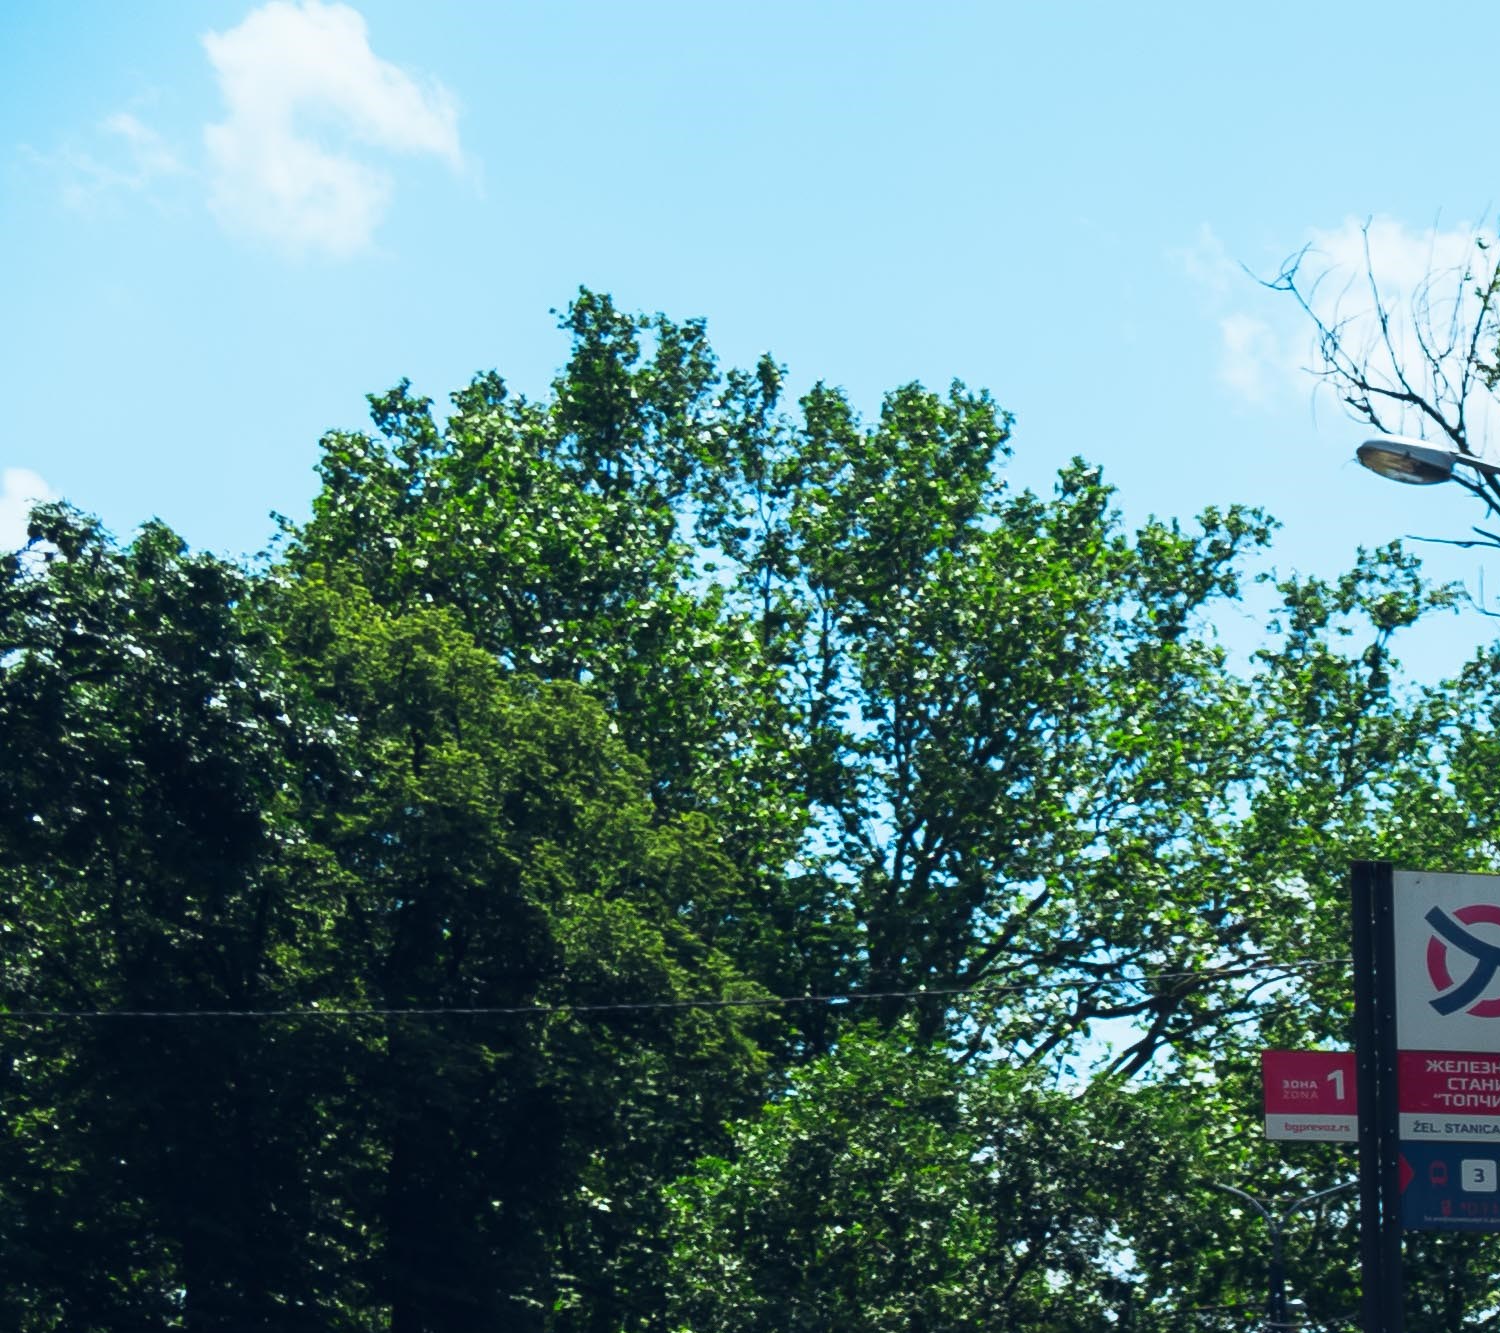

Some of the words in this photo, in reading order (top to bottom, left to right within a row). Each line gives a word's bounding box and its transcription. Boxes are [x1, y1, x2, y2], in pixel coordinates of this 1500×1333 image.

[1326, 1069, 1345, 1100] 1
[1413, 1120, 1441, 1133] ŽEL.
[1473, 1168, 1485, 1183] 3
